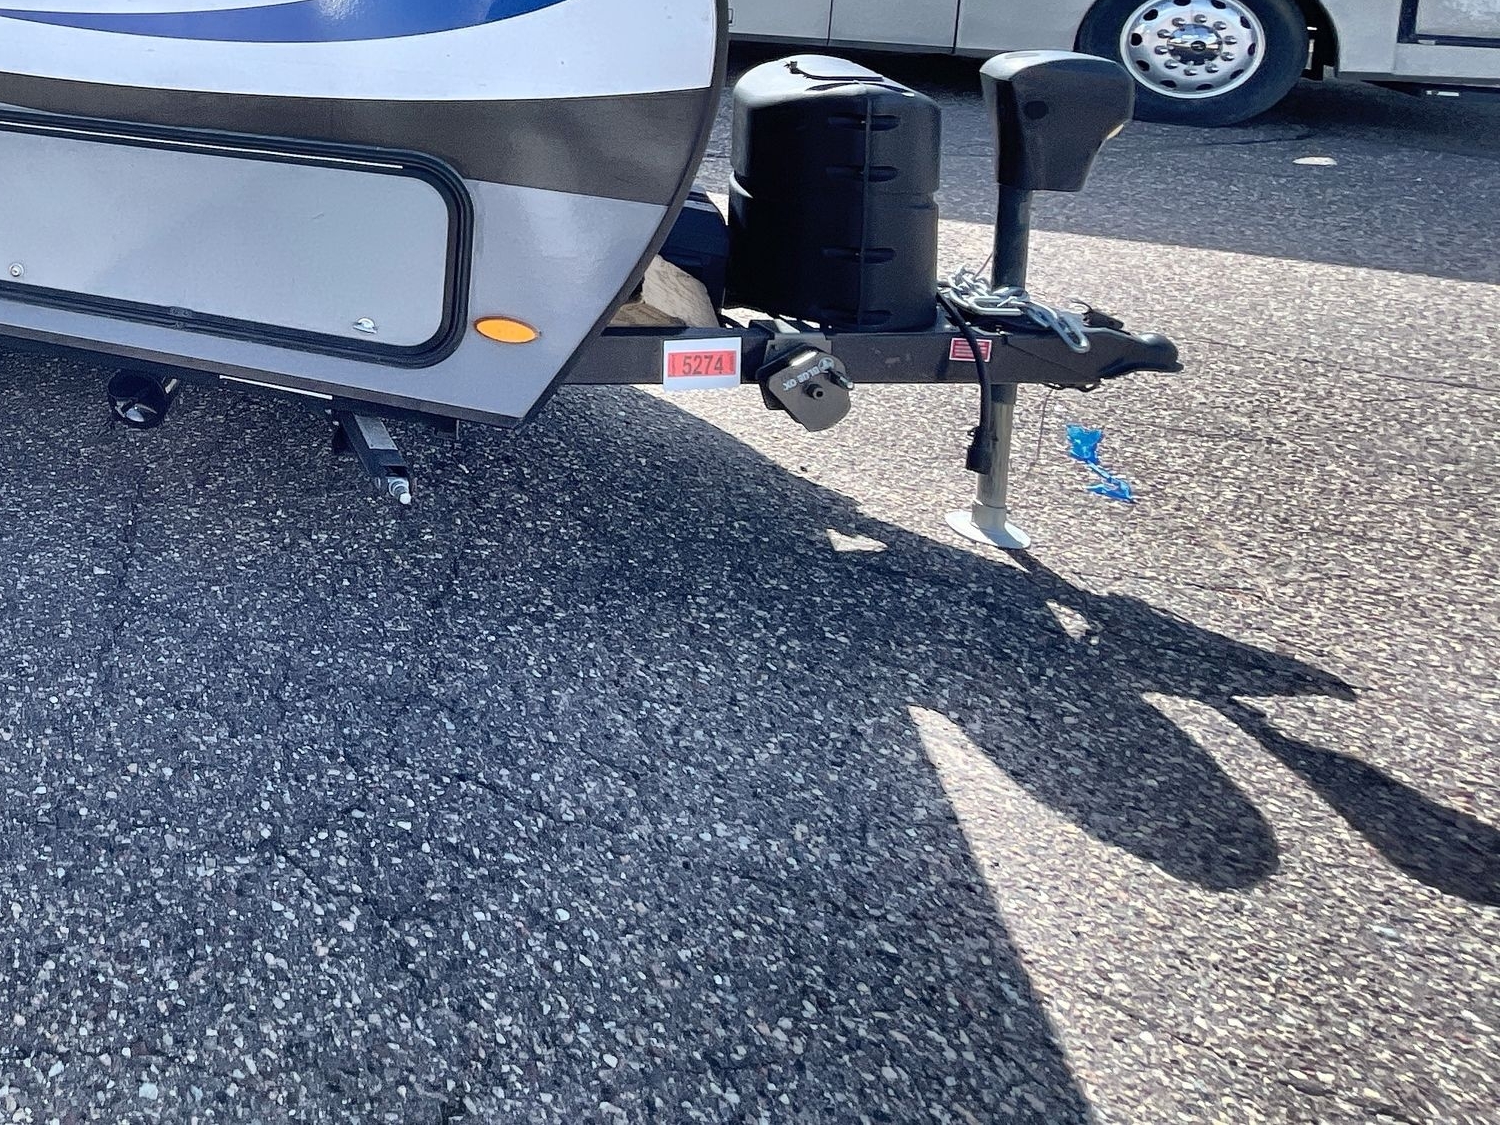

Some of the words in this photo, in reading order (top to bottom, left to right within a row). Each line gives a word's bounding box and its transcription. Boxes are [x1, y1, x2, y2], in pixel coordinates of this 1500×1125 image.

[682, 355, 723, 375] 5274
[797, 366, 820, 383] BLUE
[783, 378, 797, 391] OX
